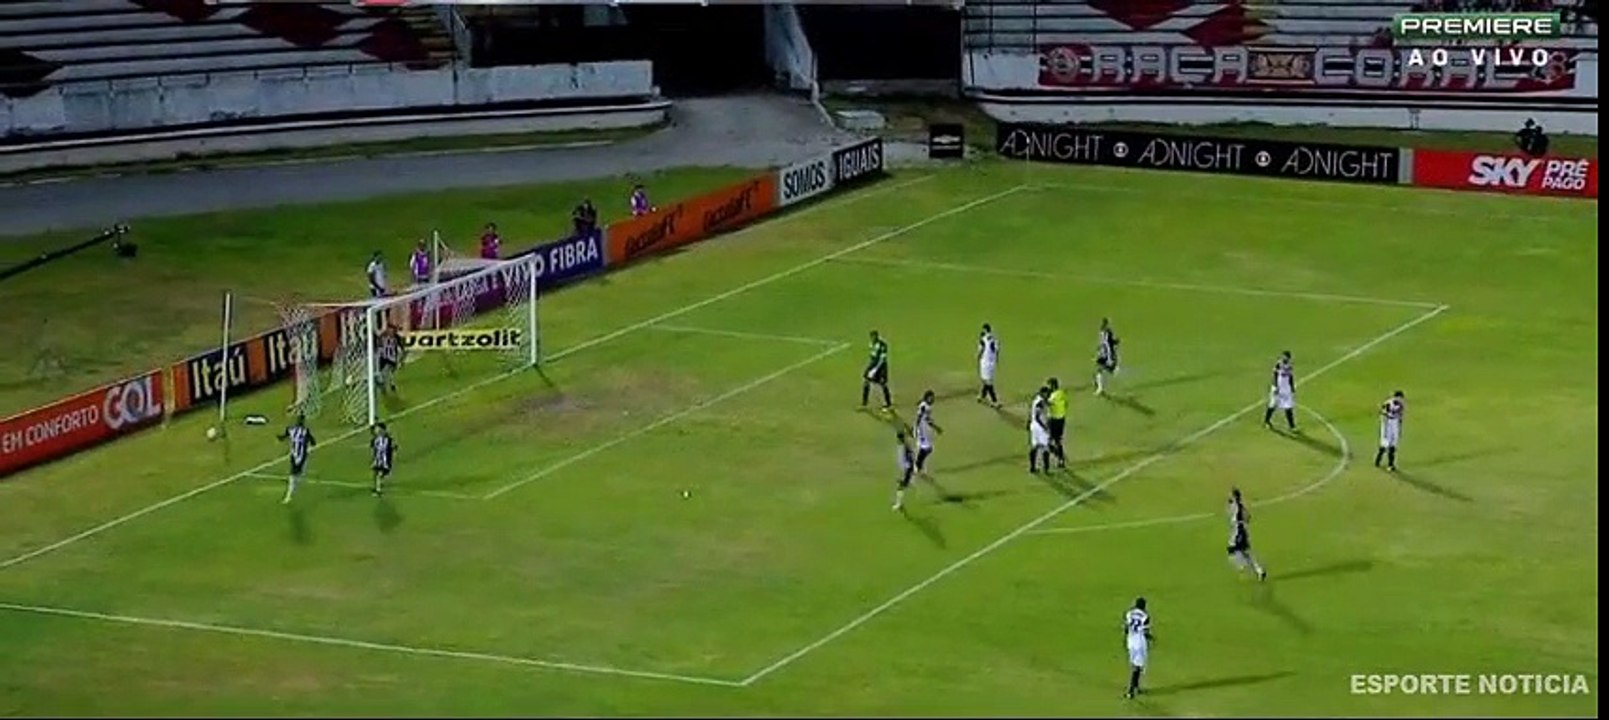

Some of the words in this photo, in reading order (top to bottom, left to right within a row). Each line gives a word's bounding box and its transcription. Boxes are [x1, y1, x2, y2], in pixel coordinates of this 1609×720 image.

[1138, 137, 1245, 171] ADNIGHT
[1281, 146, 1392, 179] ADNIGHT
[1544, 157, 1589, 177] PRÉ
[783, 160, 826, 199] SOMOS
[838, 144, 881, 181] IGUAIS
[1469, 155, 1542, 188] SKY
[1541, 175, 1587, 191] PAGO
[549, 236, 599, 274] FIBRA
[400, 329, 520, 347] uartzolit
[192, 349, 246, 400] Itaú
[25, 404, 99, 447] CONFORTO
[102, 376, 162, 430] GOL
